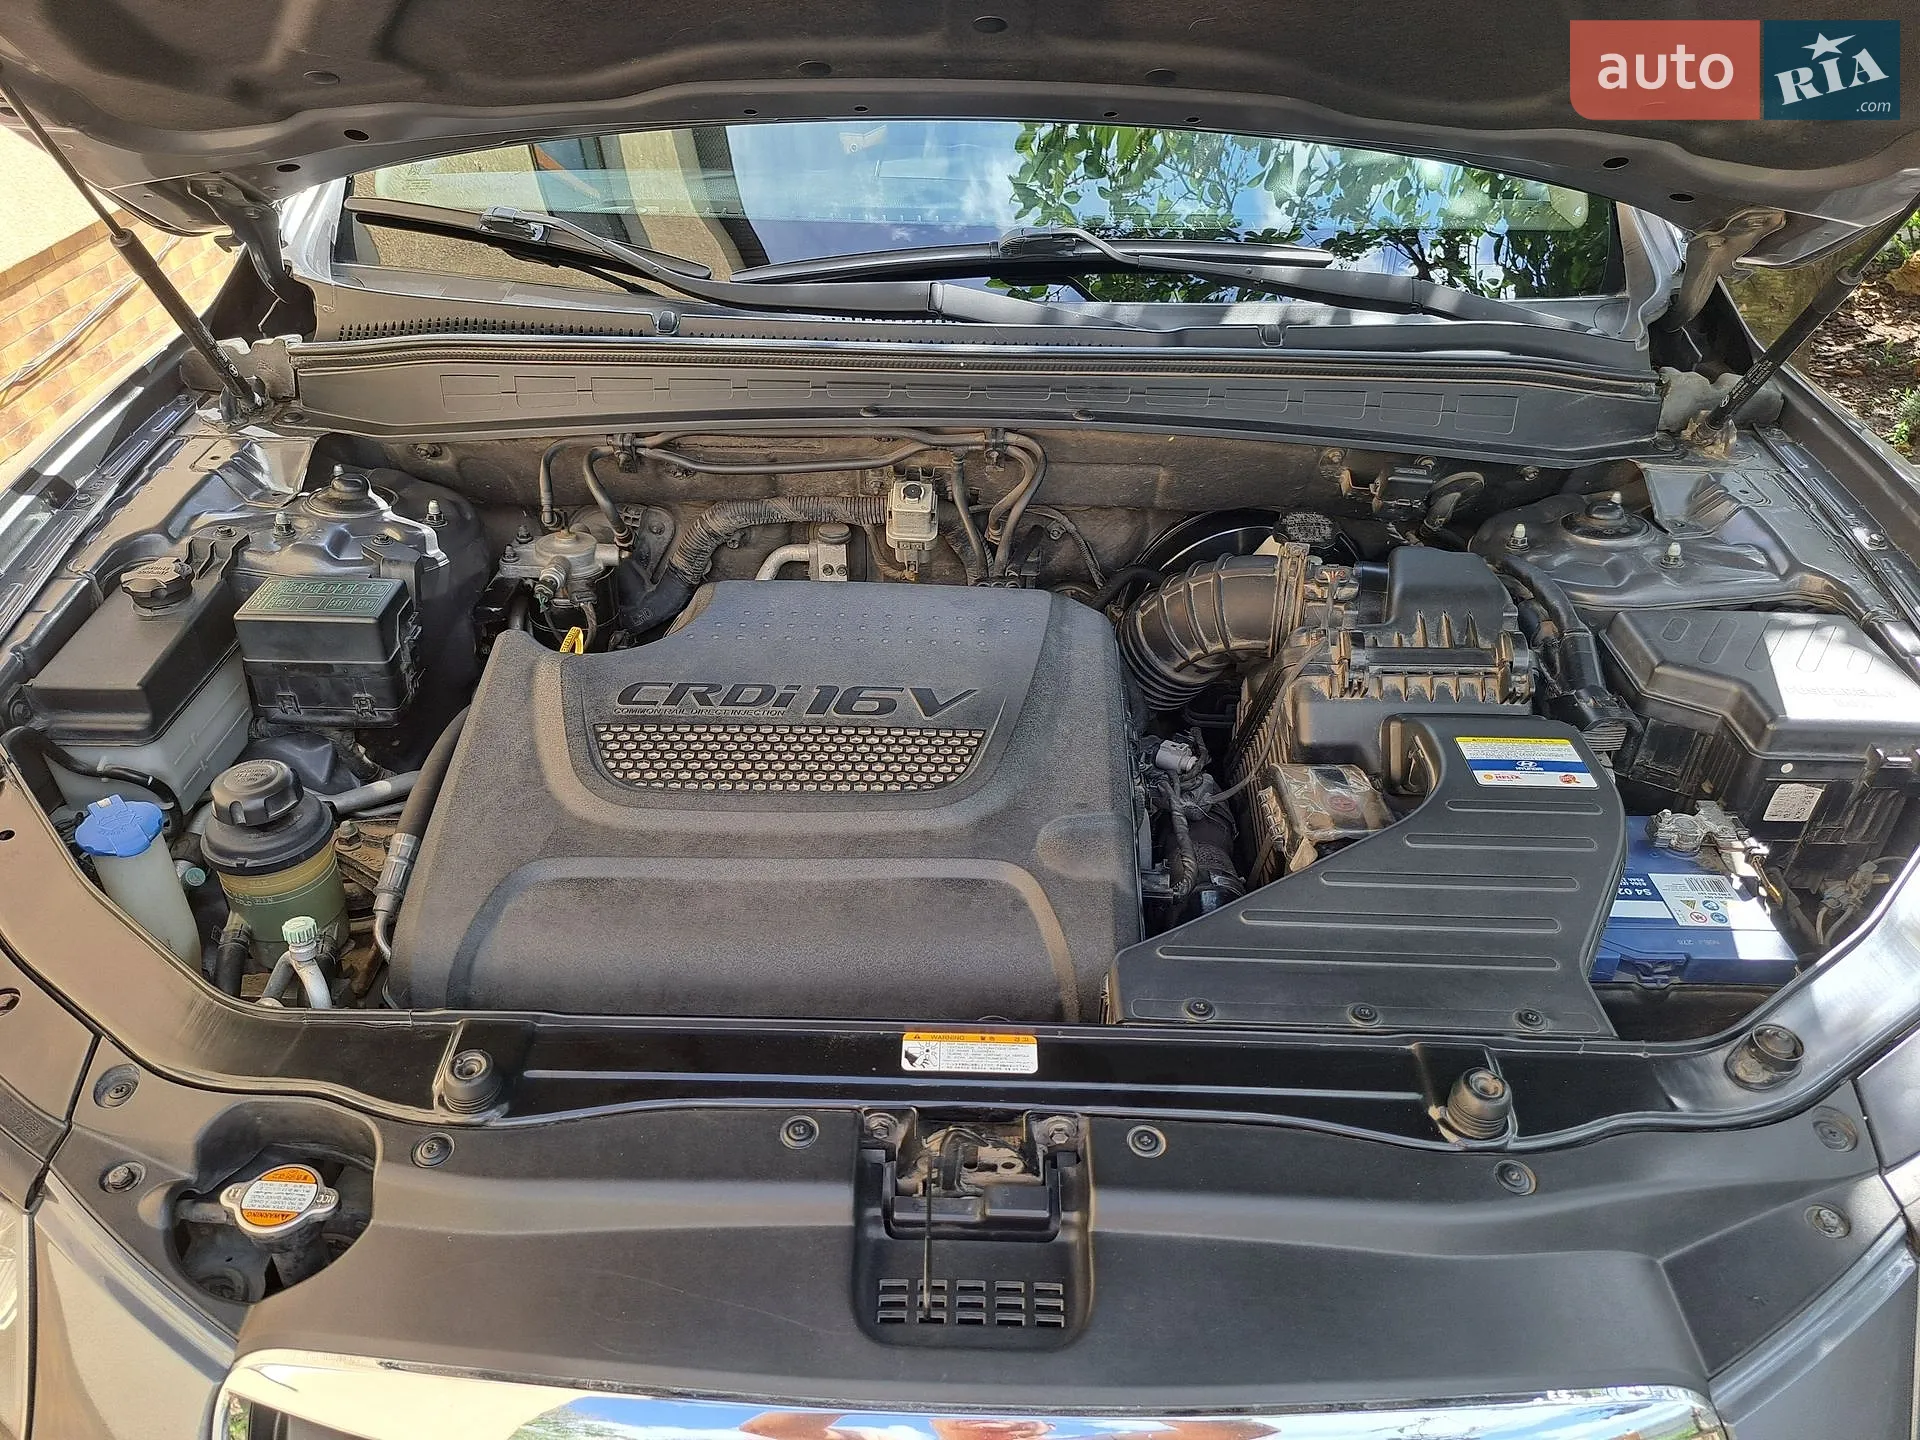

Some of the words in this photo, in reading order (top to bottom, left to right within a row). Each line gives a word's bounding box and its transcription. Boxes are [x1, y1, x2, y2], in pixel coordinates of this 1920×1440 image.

[613, 707, 662, 716] COMMON
[663, 708, 688, 716] RAIL
[690, 708, 730, 717] DIRECT
[730, 709, 786, 717] INJECTION
